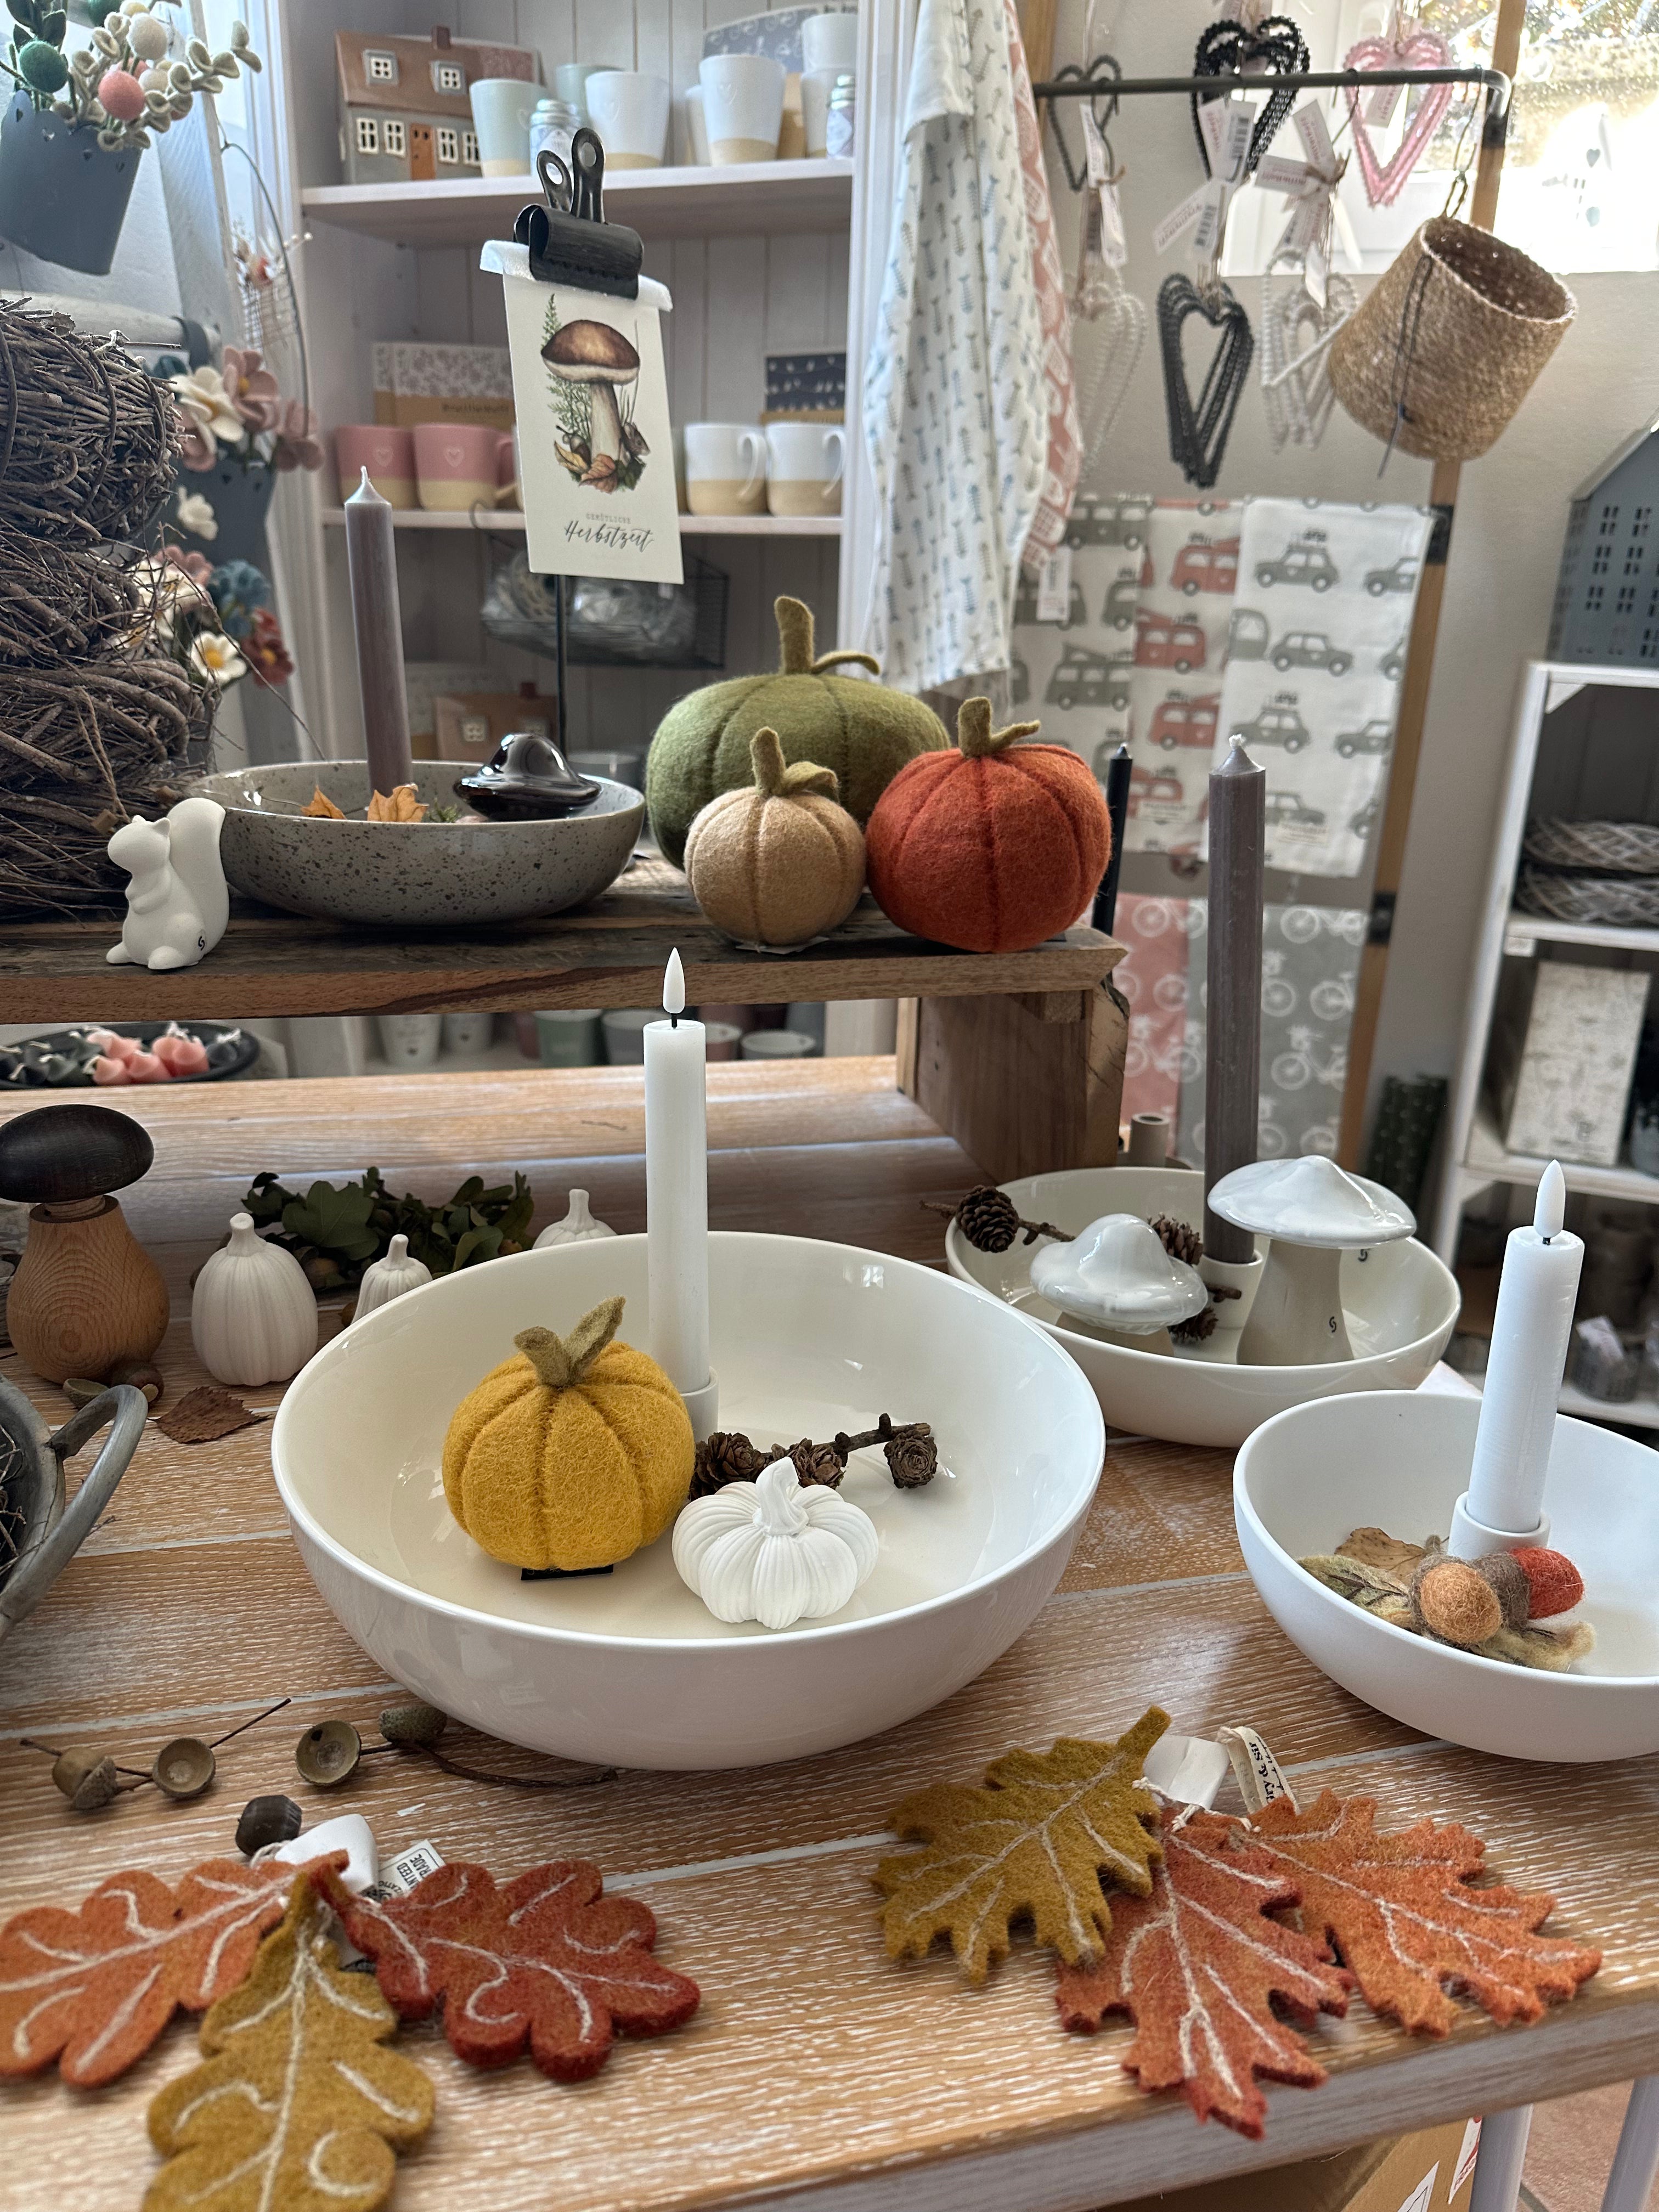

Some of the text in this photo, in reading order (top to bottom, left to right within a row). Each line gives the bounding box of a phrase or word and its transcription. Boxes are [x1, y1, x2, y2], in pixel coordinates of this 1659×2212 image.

[564, 521, 654, 552] Herbstzeit
[1259, 1763, 1268, 1777] &
[410, 1854, 432, 1878] RADE
